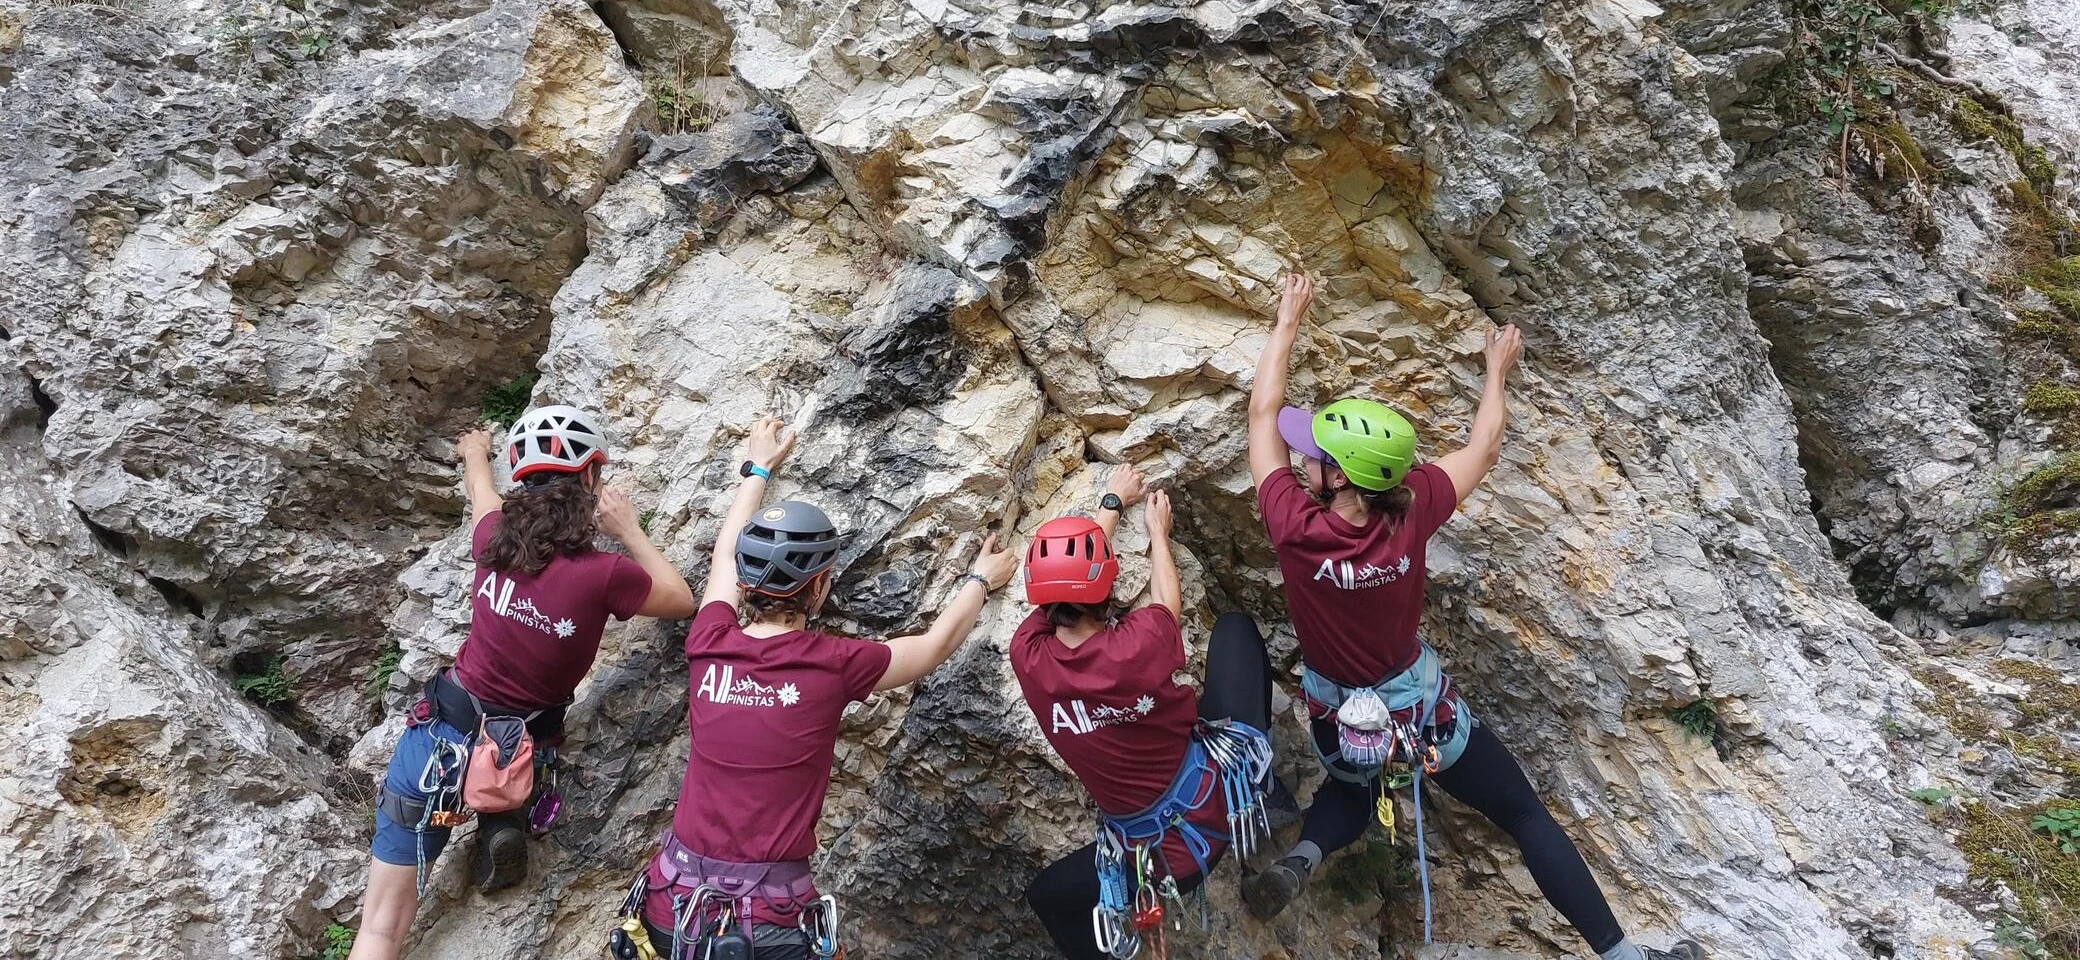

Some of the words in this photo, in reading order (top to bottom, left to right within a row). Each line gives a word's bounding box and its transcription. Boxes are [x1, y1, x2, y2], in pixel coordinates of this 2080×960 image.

[1355, 573, 1397, 590] PINISTAS
[505, 608, 551, 634] PINISTAS
[726, 694, 775, 707] PINISTAS
[1091, 712, 1138, 731] PINISTAS
